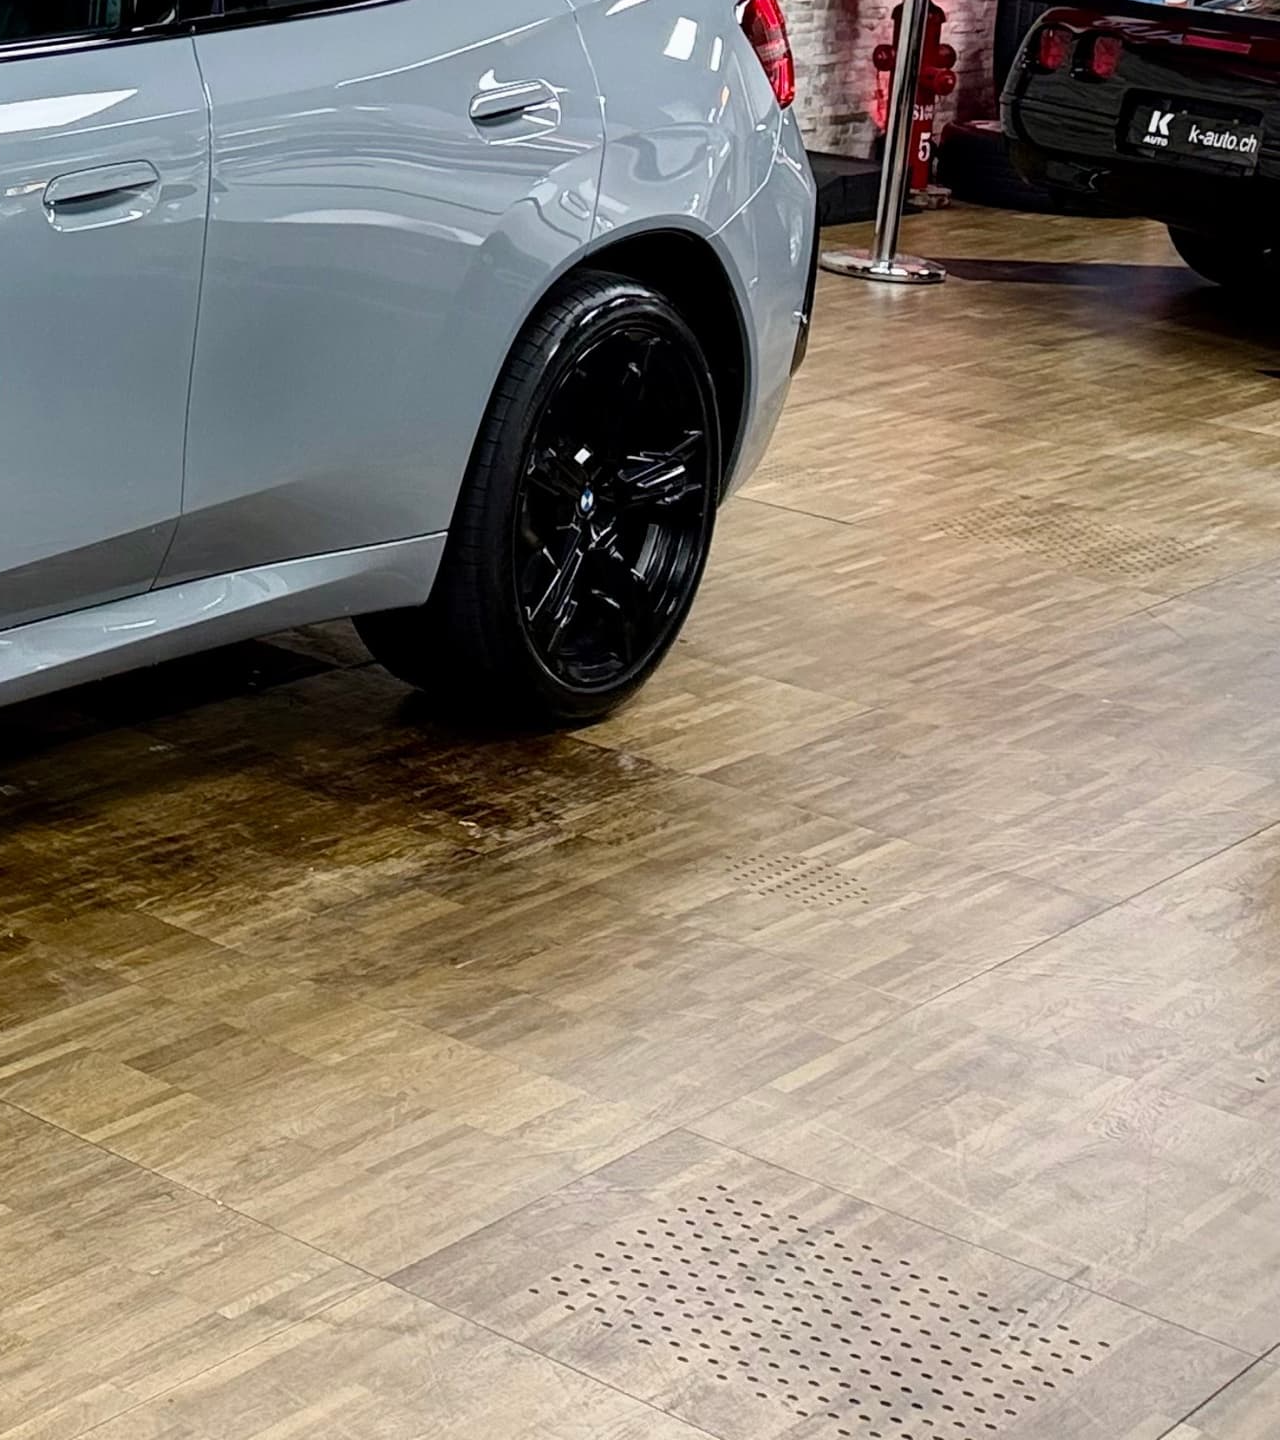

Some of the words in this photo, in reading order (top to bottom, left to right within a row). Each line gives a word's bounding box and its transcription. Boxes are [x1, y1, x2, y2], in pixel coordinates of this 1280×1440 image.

[1148, 110, 1175, 136] K
[918, 132, 931, 162] 5
[1143, 135, 1168, 147] AUTO
[1188, 124, 1257, 153] k-auto.ch
